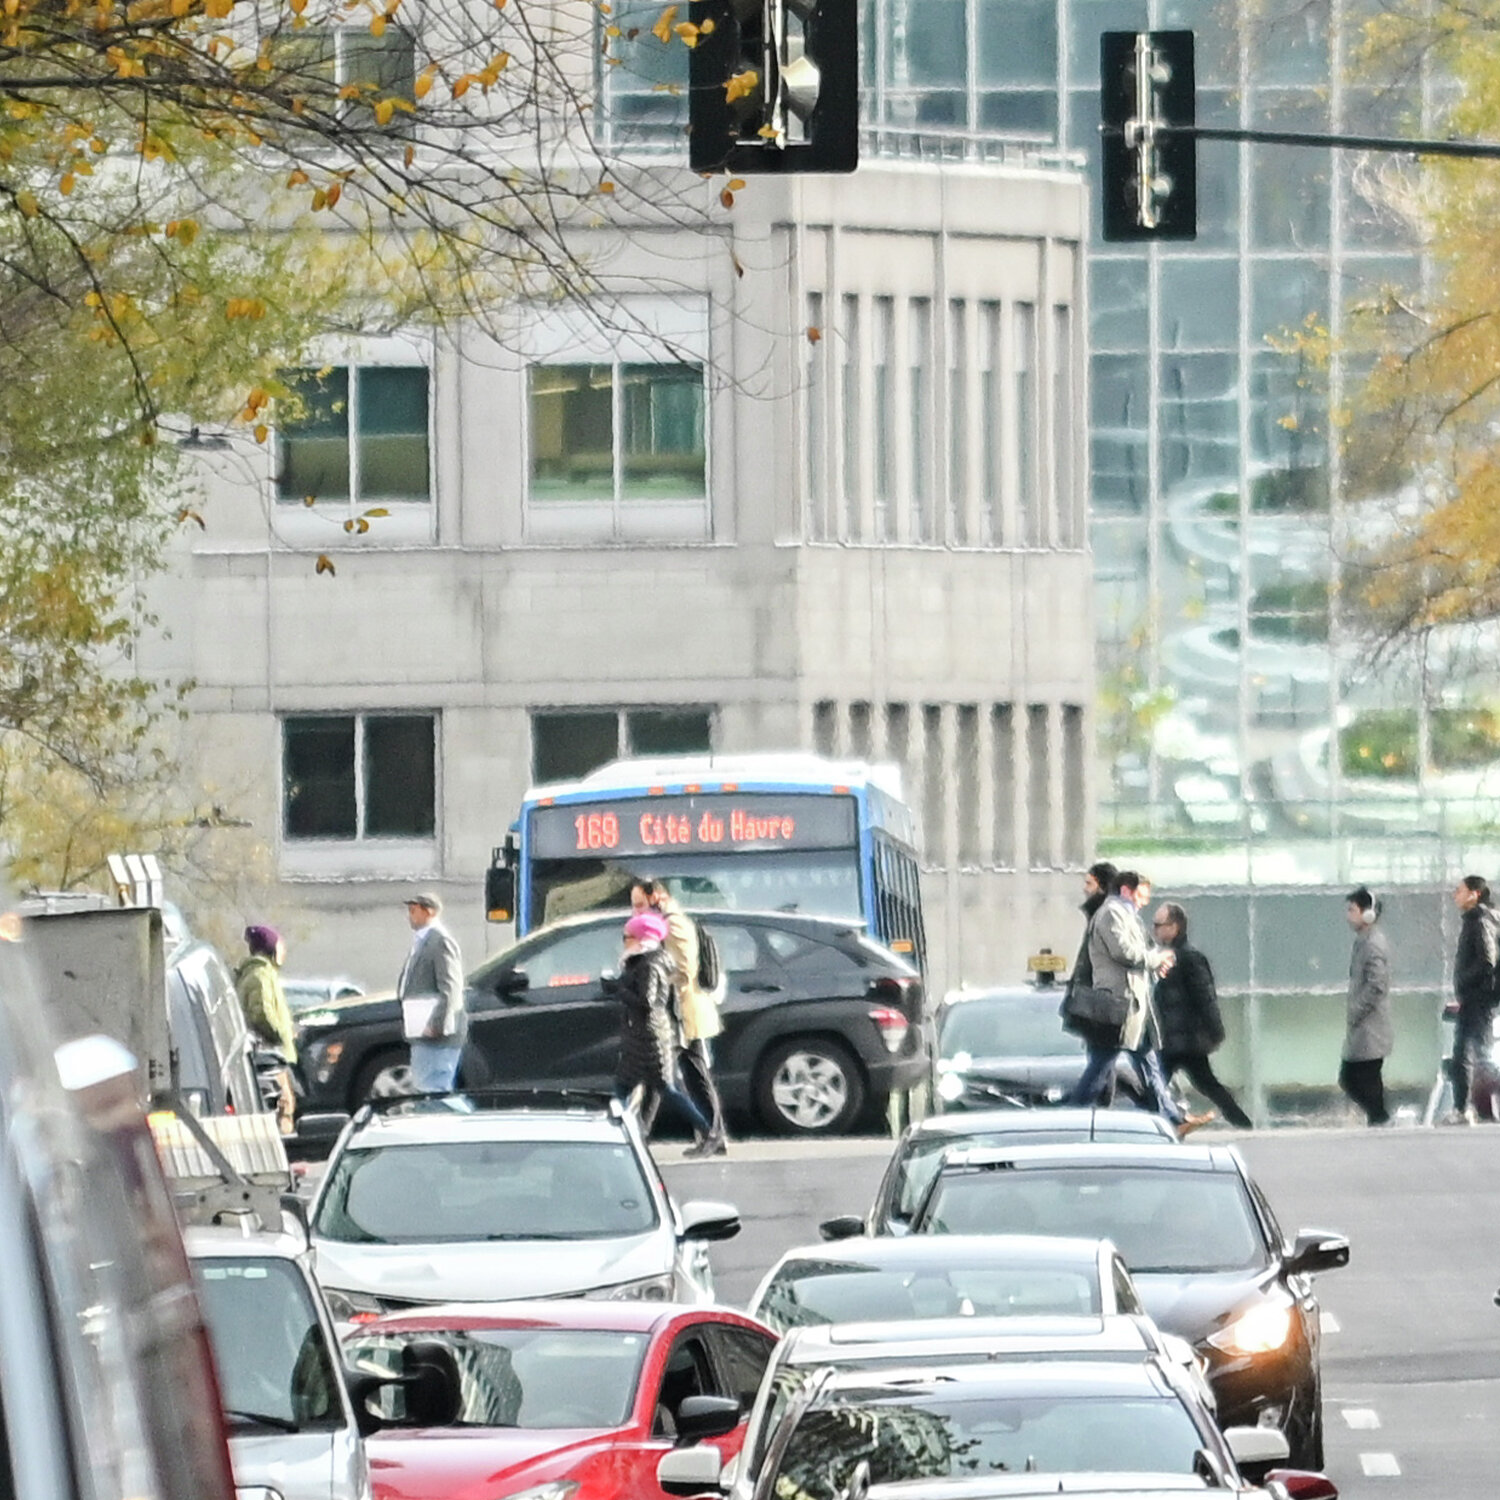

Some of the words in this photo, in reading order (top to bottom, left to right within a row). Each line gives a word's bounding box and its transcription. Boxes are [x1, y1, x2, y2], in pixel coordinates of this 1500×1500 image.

[639, 813, 691, 845] Cité
[698, 811, 724, 843] du
[730, 808, 795, 841] Havre
